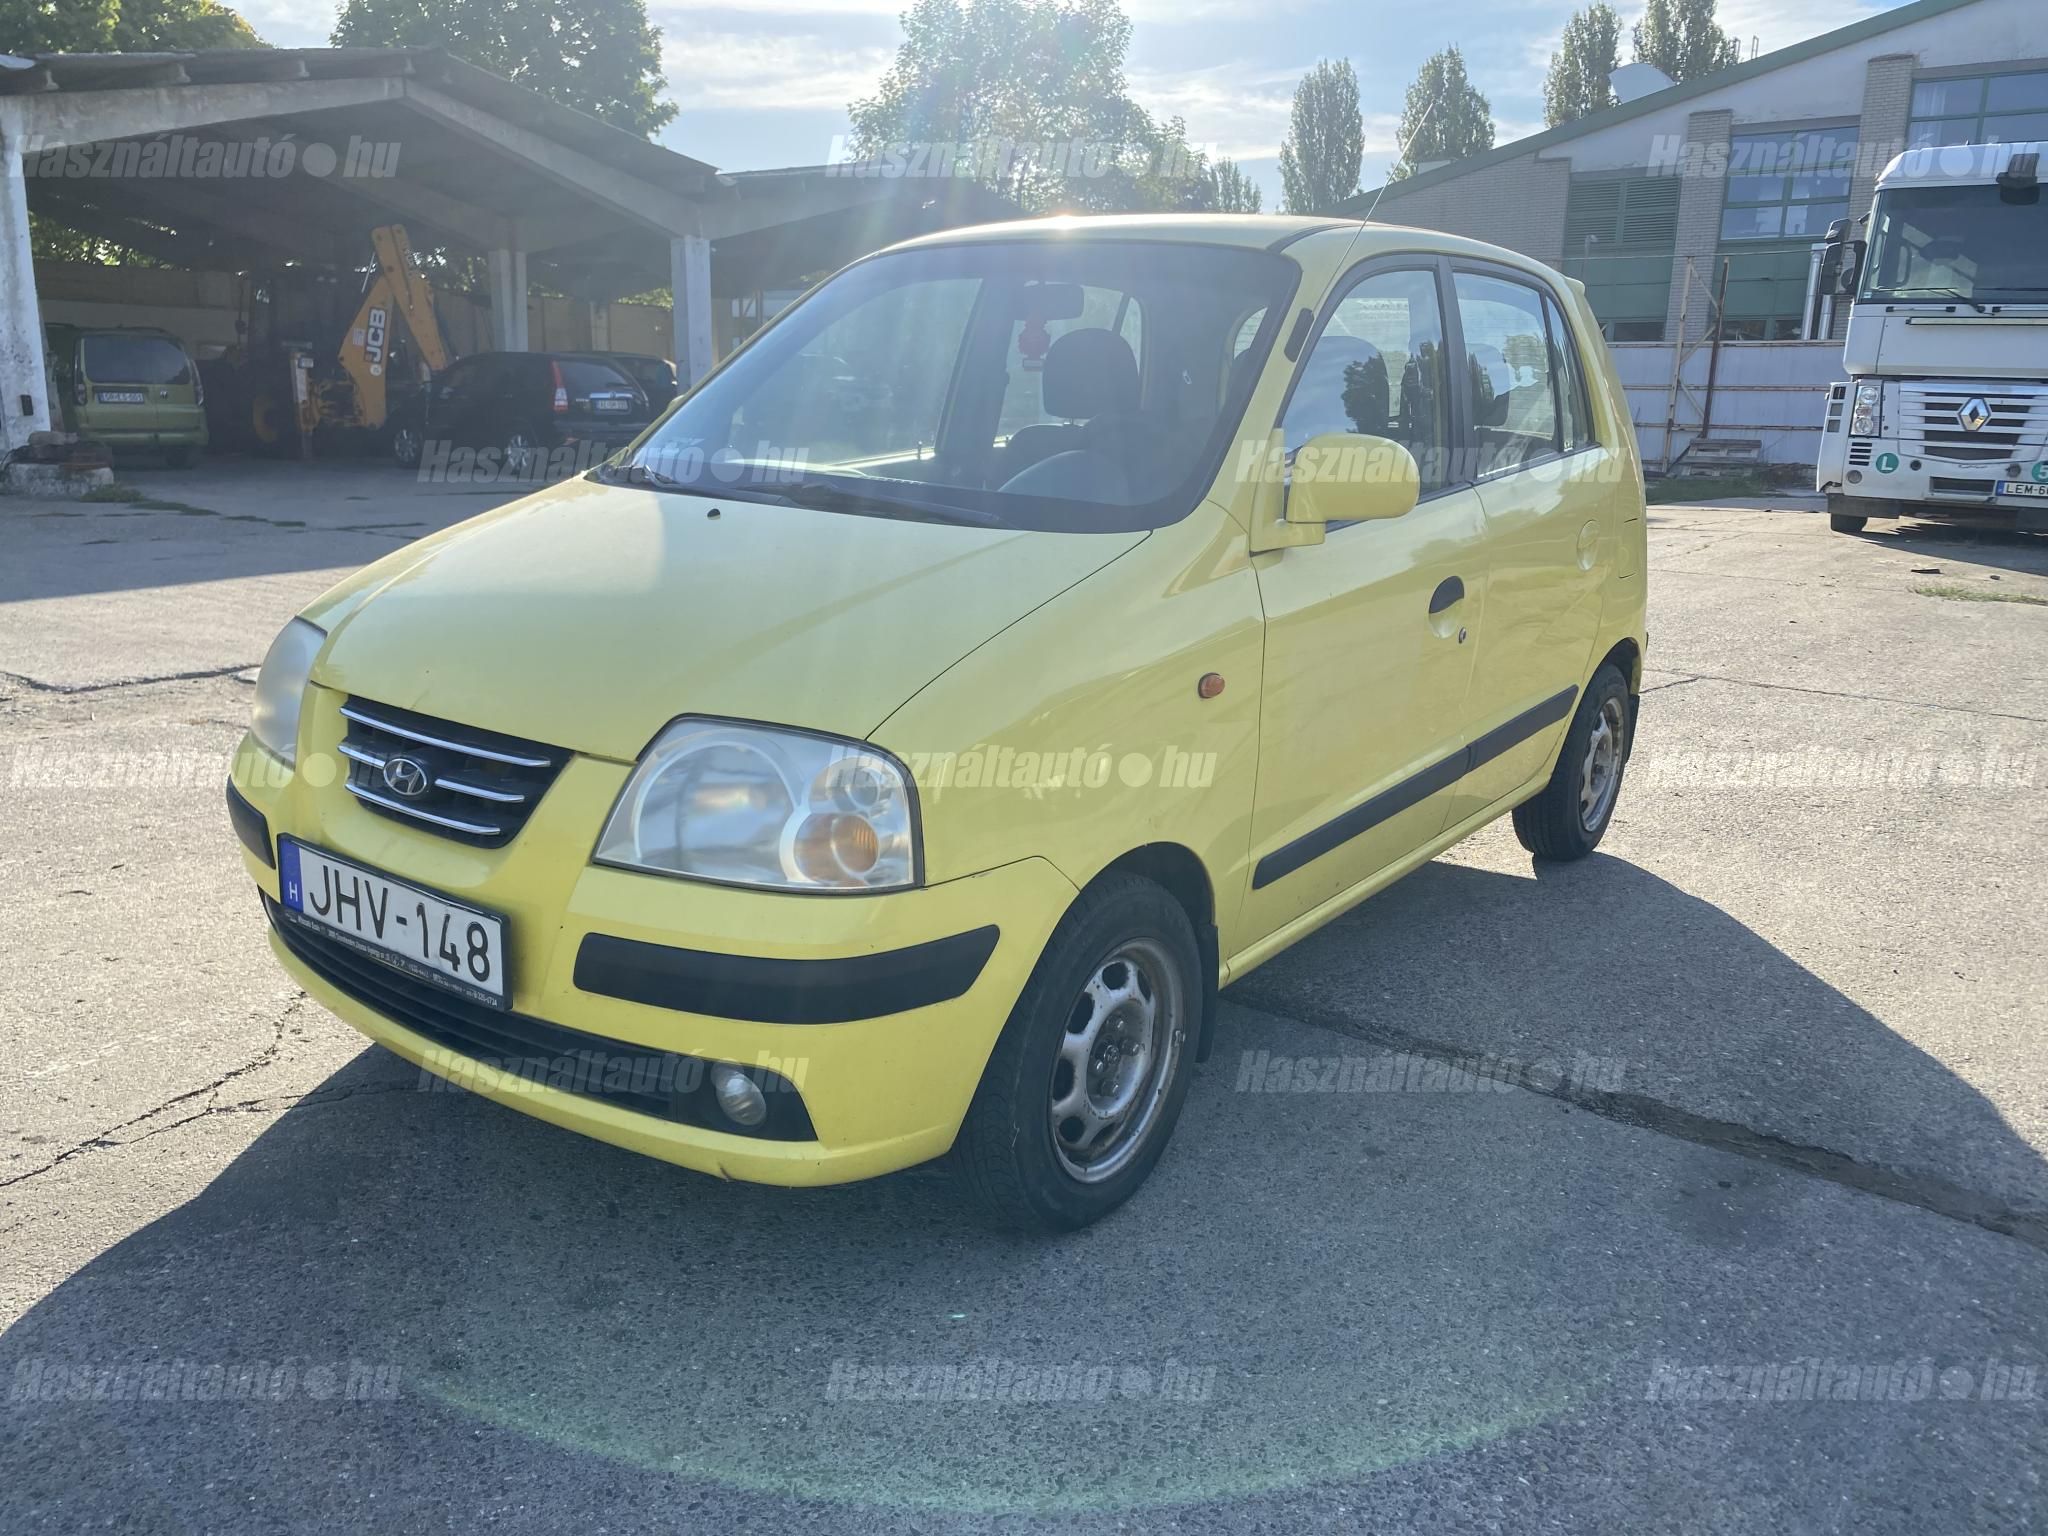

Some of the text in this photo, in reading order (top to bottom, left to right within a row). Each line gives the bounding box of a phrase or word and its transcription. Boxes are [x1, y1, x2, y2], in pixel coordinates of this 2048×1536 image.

[366, 309, 386, 362] JCB
[1881, 456, 1893, 471] L
[2006, 483, 2048, 496] LEM-6
[289, 880, 298, 903] H
[309, 864, 490, 982] JHV-148
